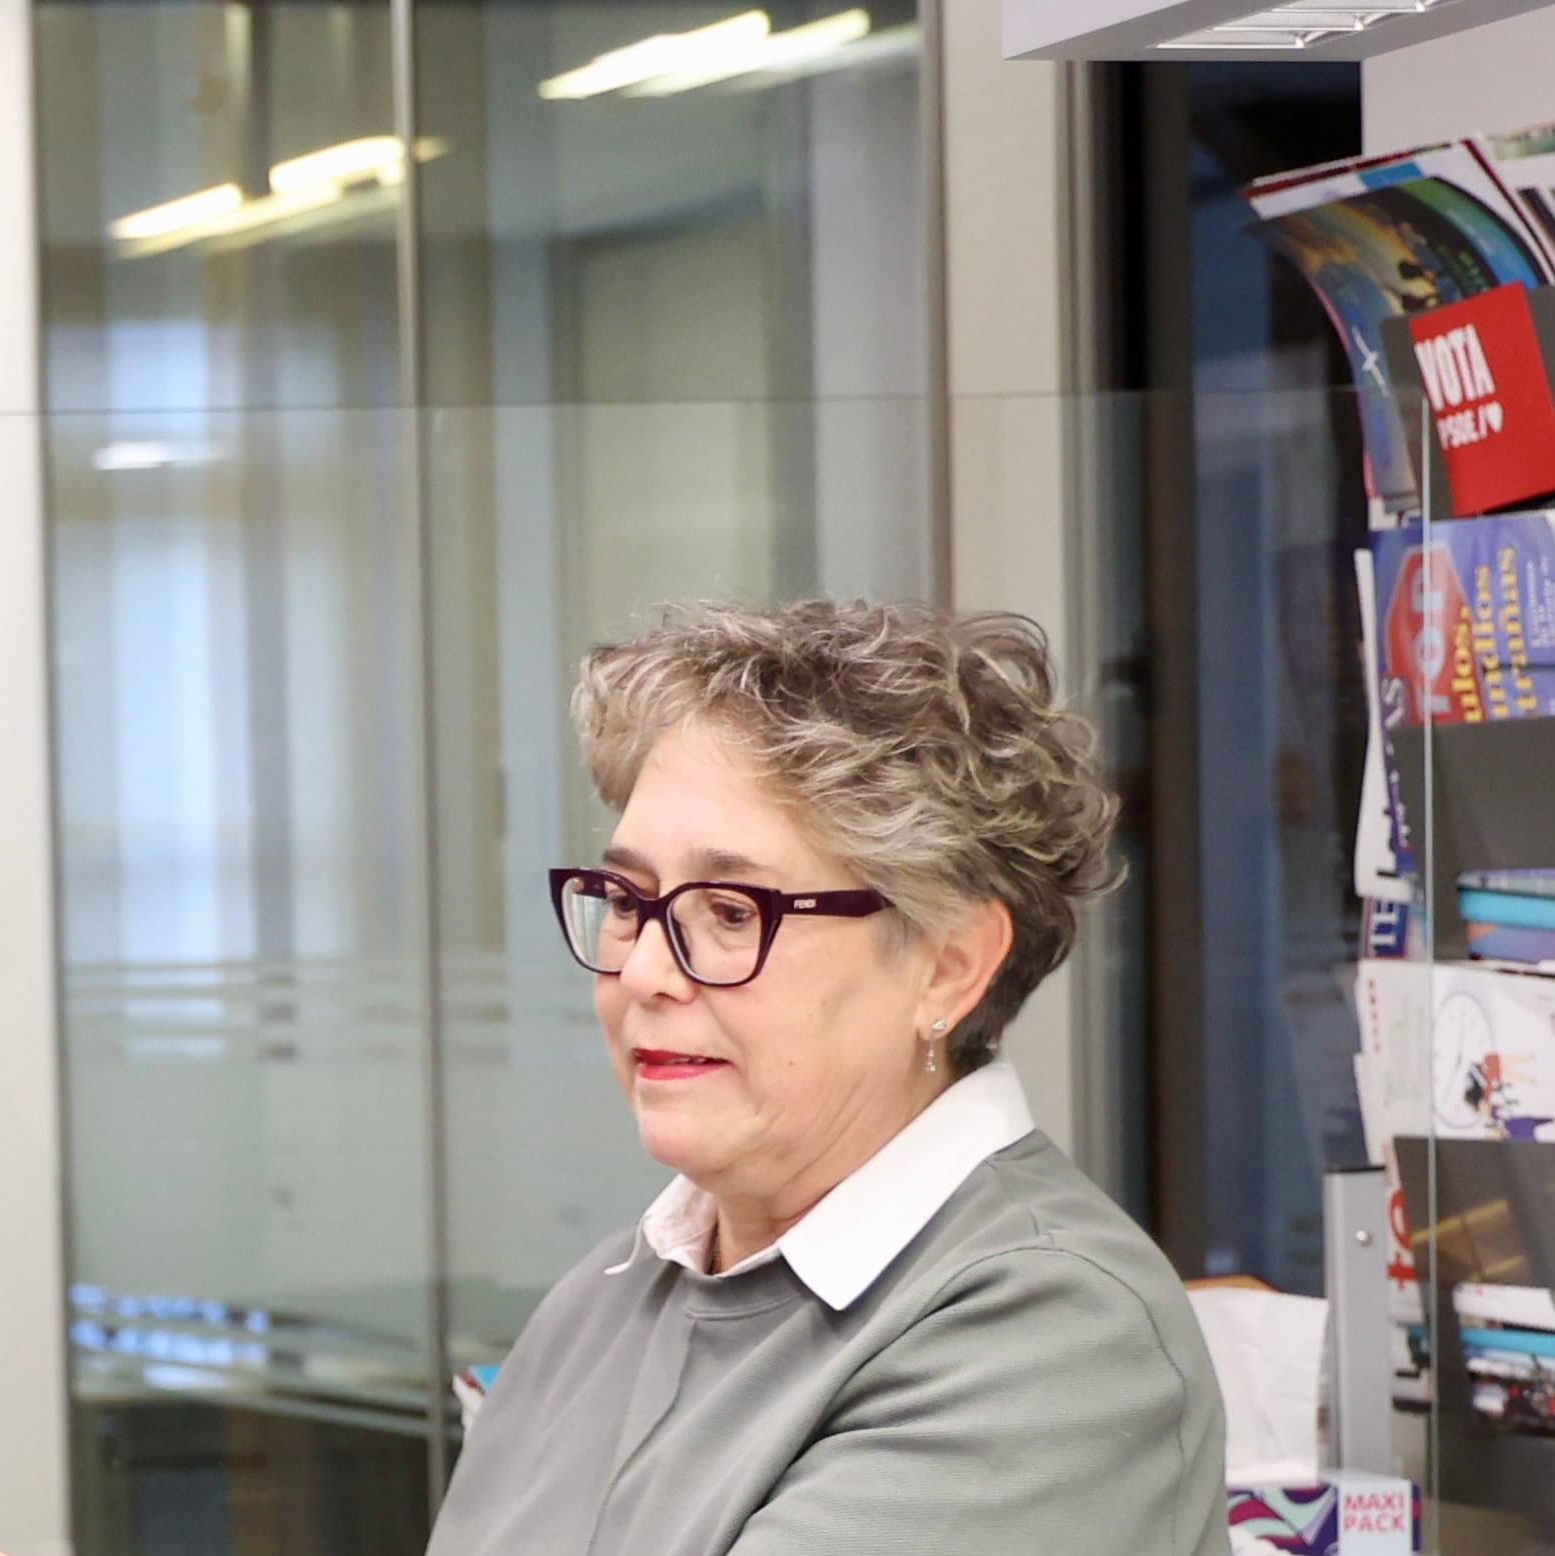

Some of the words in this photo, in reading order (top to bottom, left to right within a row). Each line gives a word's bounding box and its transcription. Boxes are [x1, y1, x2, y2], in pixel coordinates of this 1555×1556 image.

[1413, 322, 1497, 411] VOTA
[1344, 1492, 1405, 1511] MAXI
[1343, 1514, 1405, 1533] PACK
